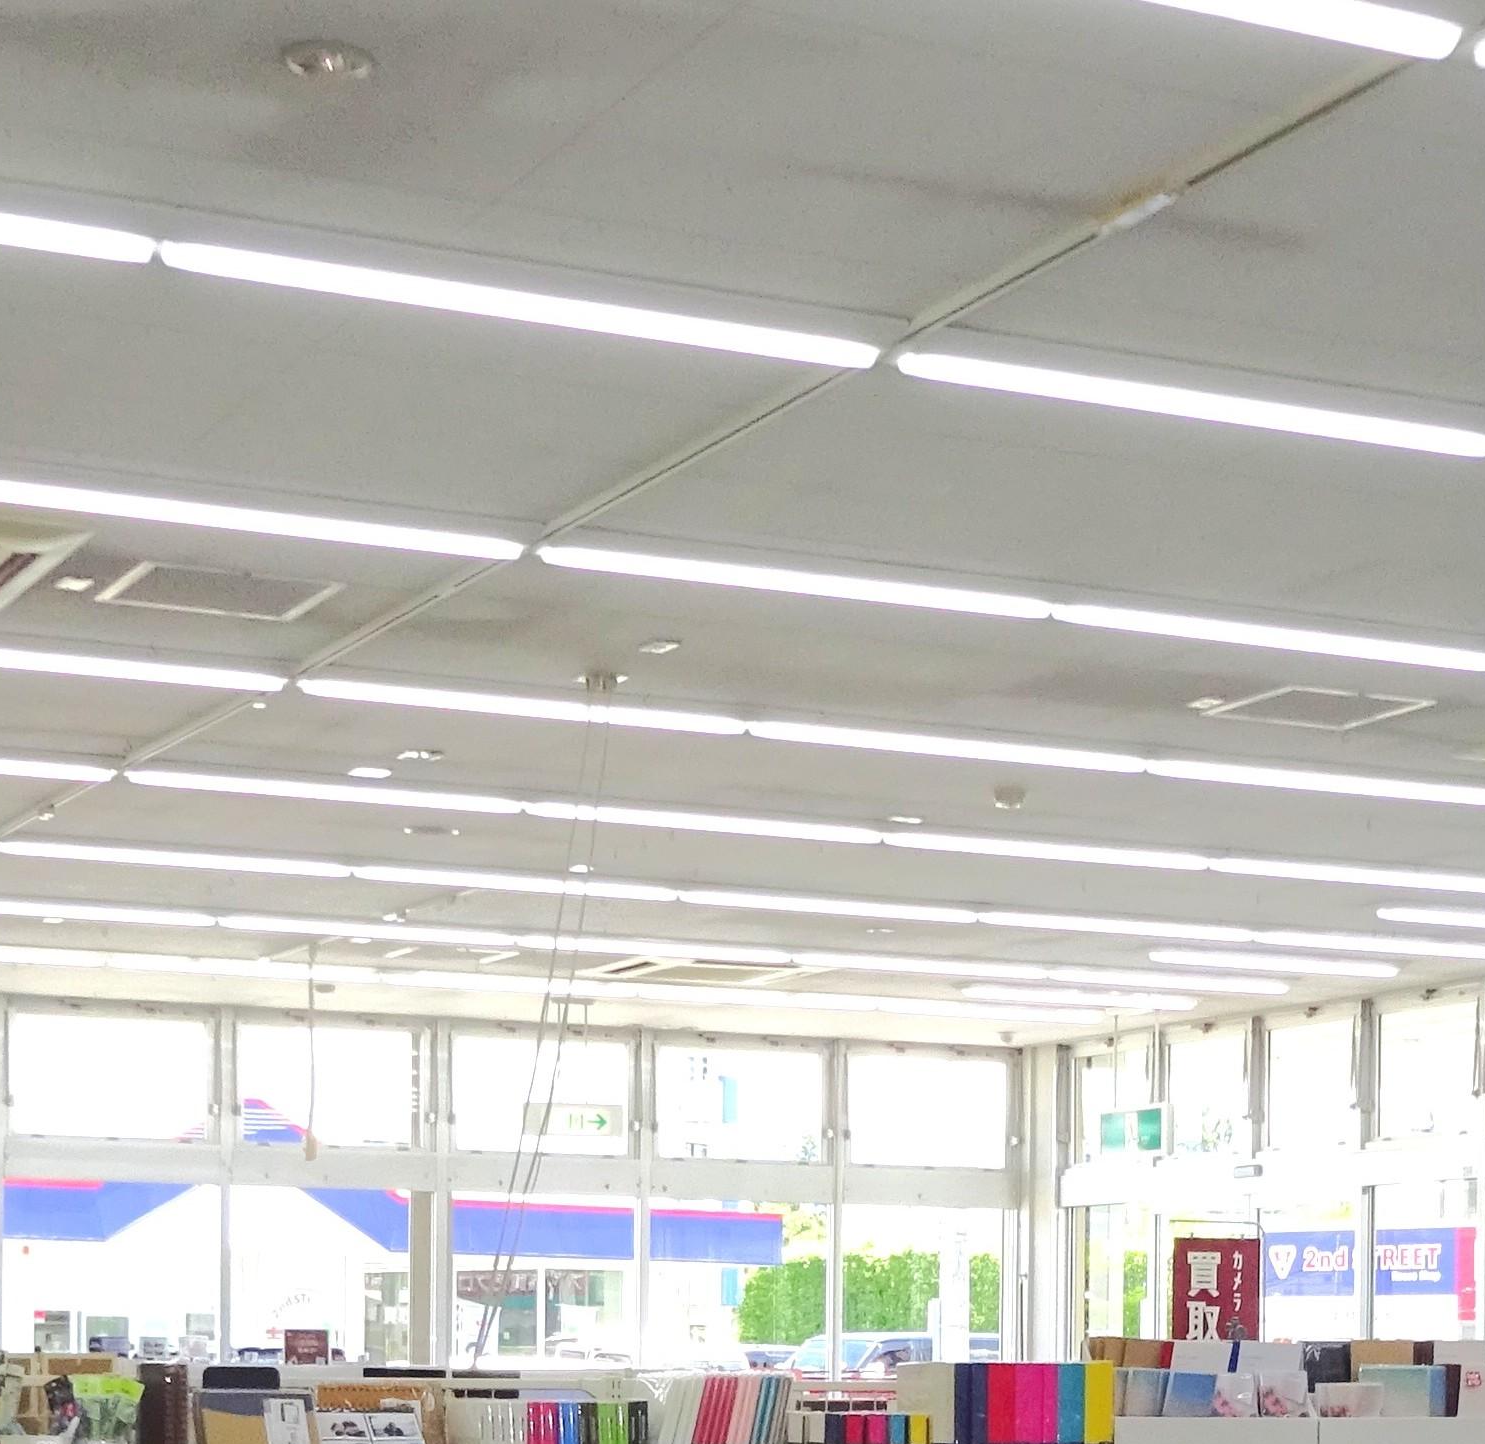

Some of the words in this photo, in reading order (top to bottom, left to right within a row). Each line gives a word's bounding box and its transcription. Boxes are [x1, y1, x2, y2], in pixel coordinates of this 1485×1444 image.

[1232, 1250, 1244, 1312] カメラ
[1304, 1248, 1347, 1269] 2nd
[1375, 1246, 1440, 1268] REET
[1186, 1251, 1222, 1340] 買取
